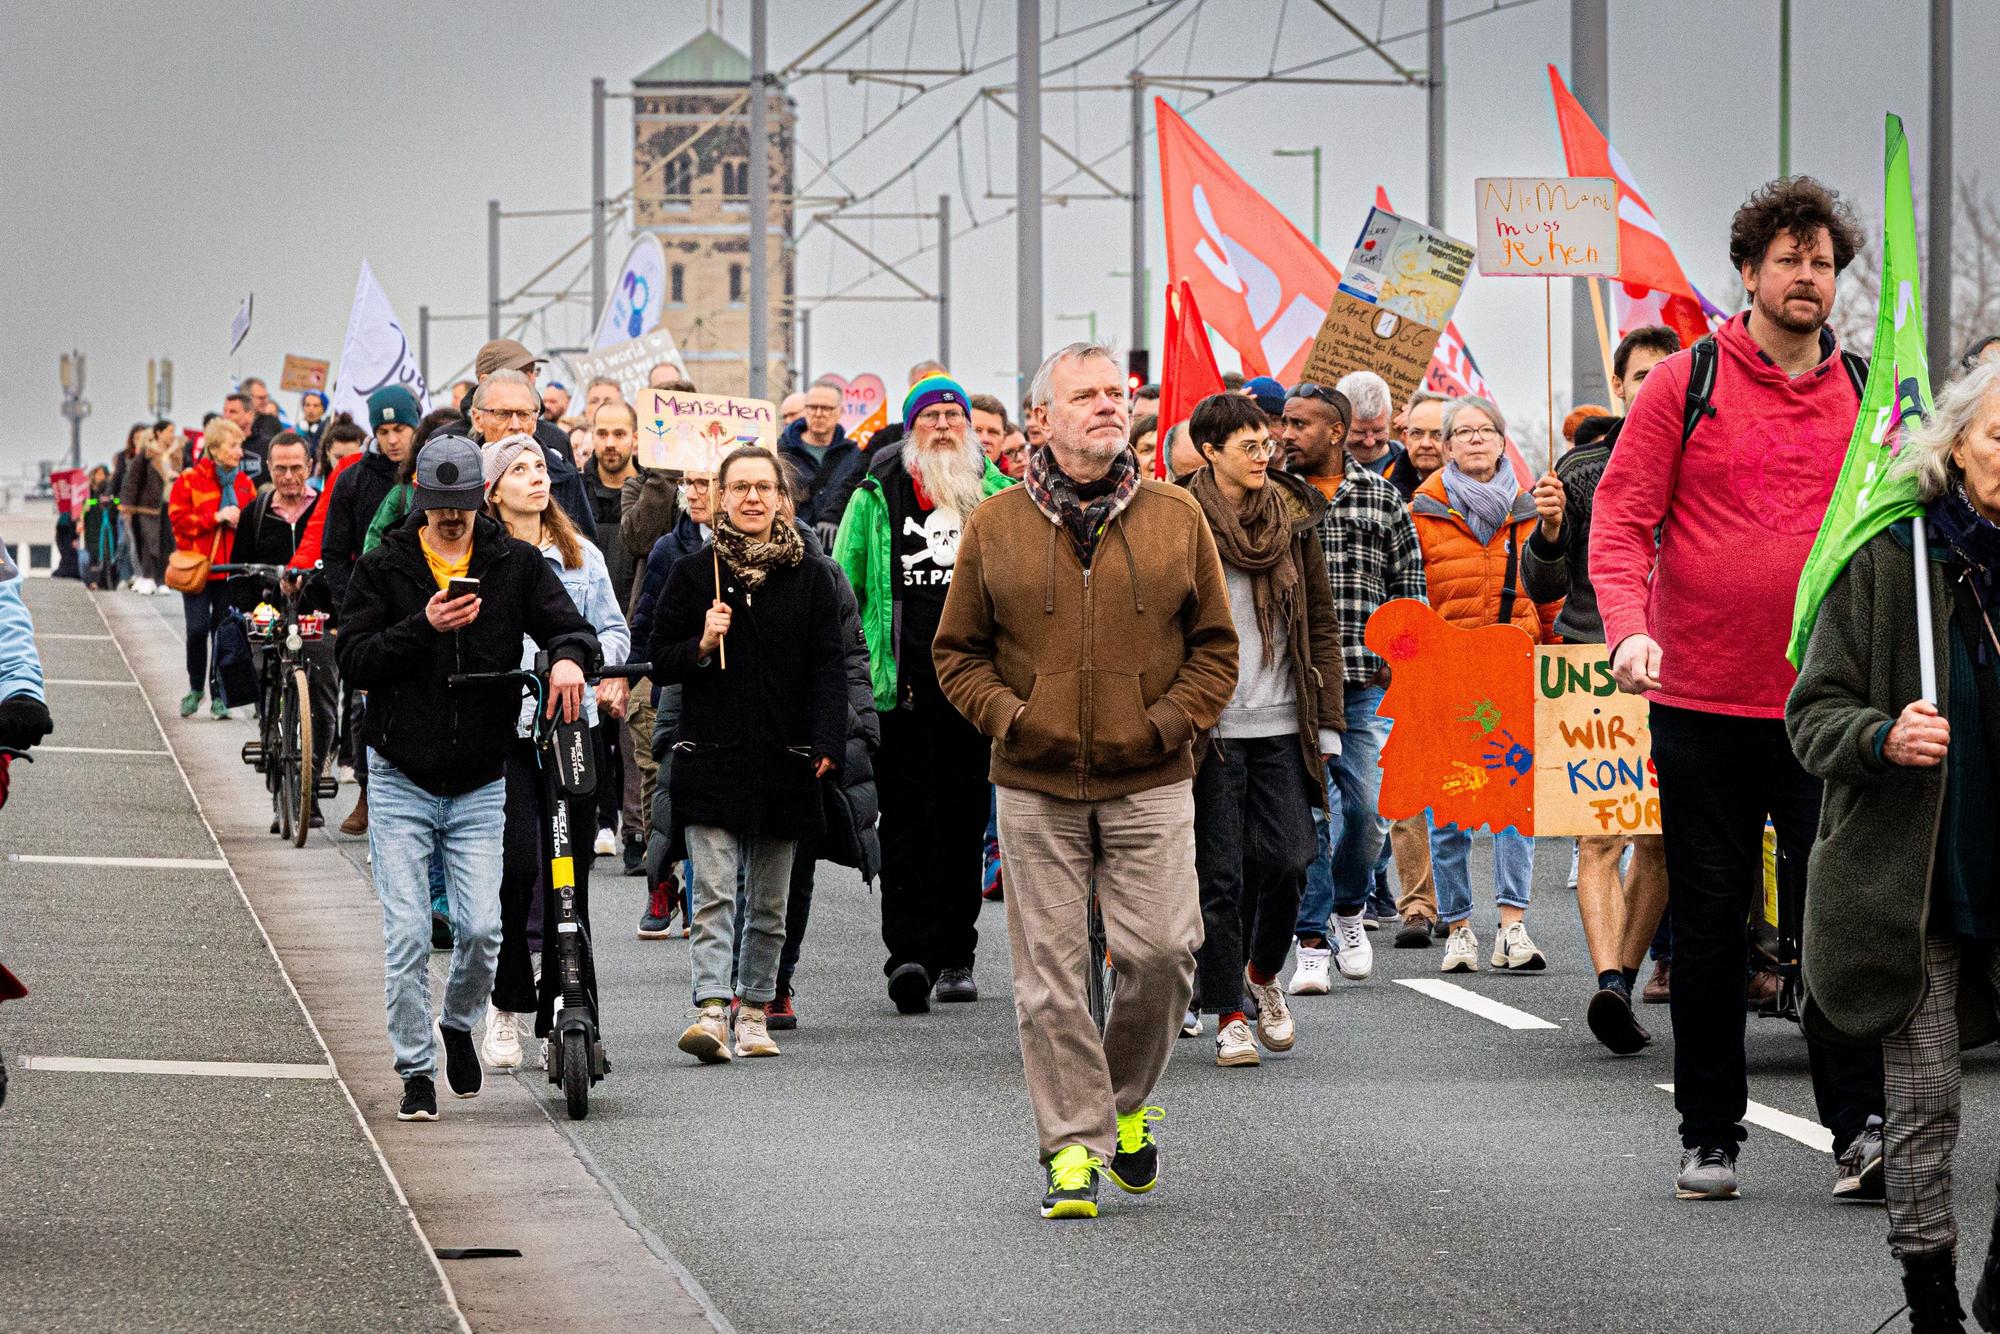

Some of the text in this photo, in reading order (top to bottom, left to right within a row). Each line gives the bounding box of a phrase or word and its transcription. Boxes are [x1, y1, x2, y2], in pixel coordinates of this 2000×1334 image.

[1496, 217, 1560, 237] muss
[1502, 231, 1598, 267] gehen
[1399, 322, 1430, 347] GG
[604, 340, 645, 367] world
[654, 393, 771, 421] Menschen
[845, 387, 876, 400] MO
[903, 569, 954, 586] ST. PA
[1540, 655, 1617, 699] UNS
[570, 747, 580, 785] MOTION
[573, 731, 585, 772] MEGA
[552, 816, 560, 857] MOTION
[557, 800, 568, 843] MEGA
